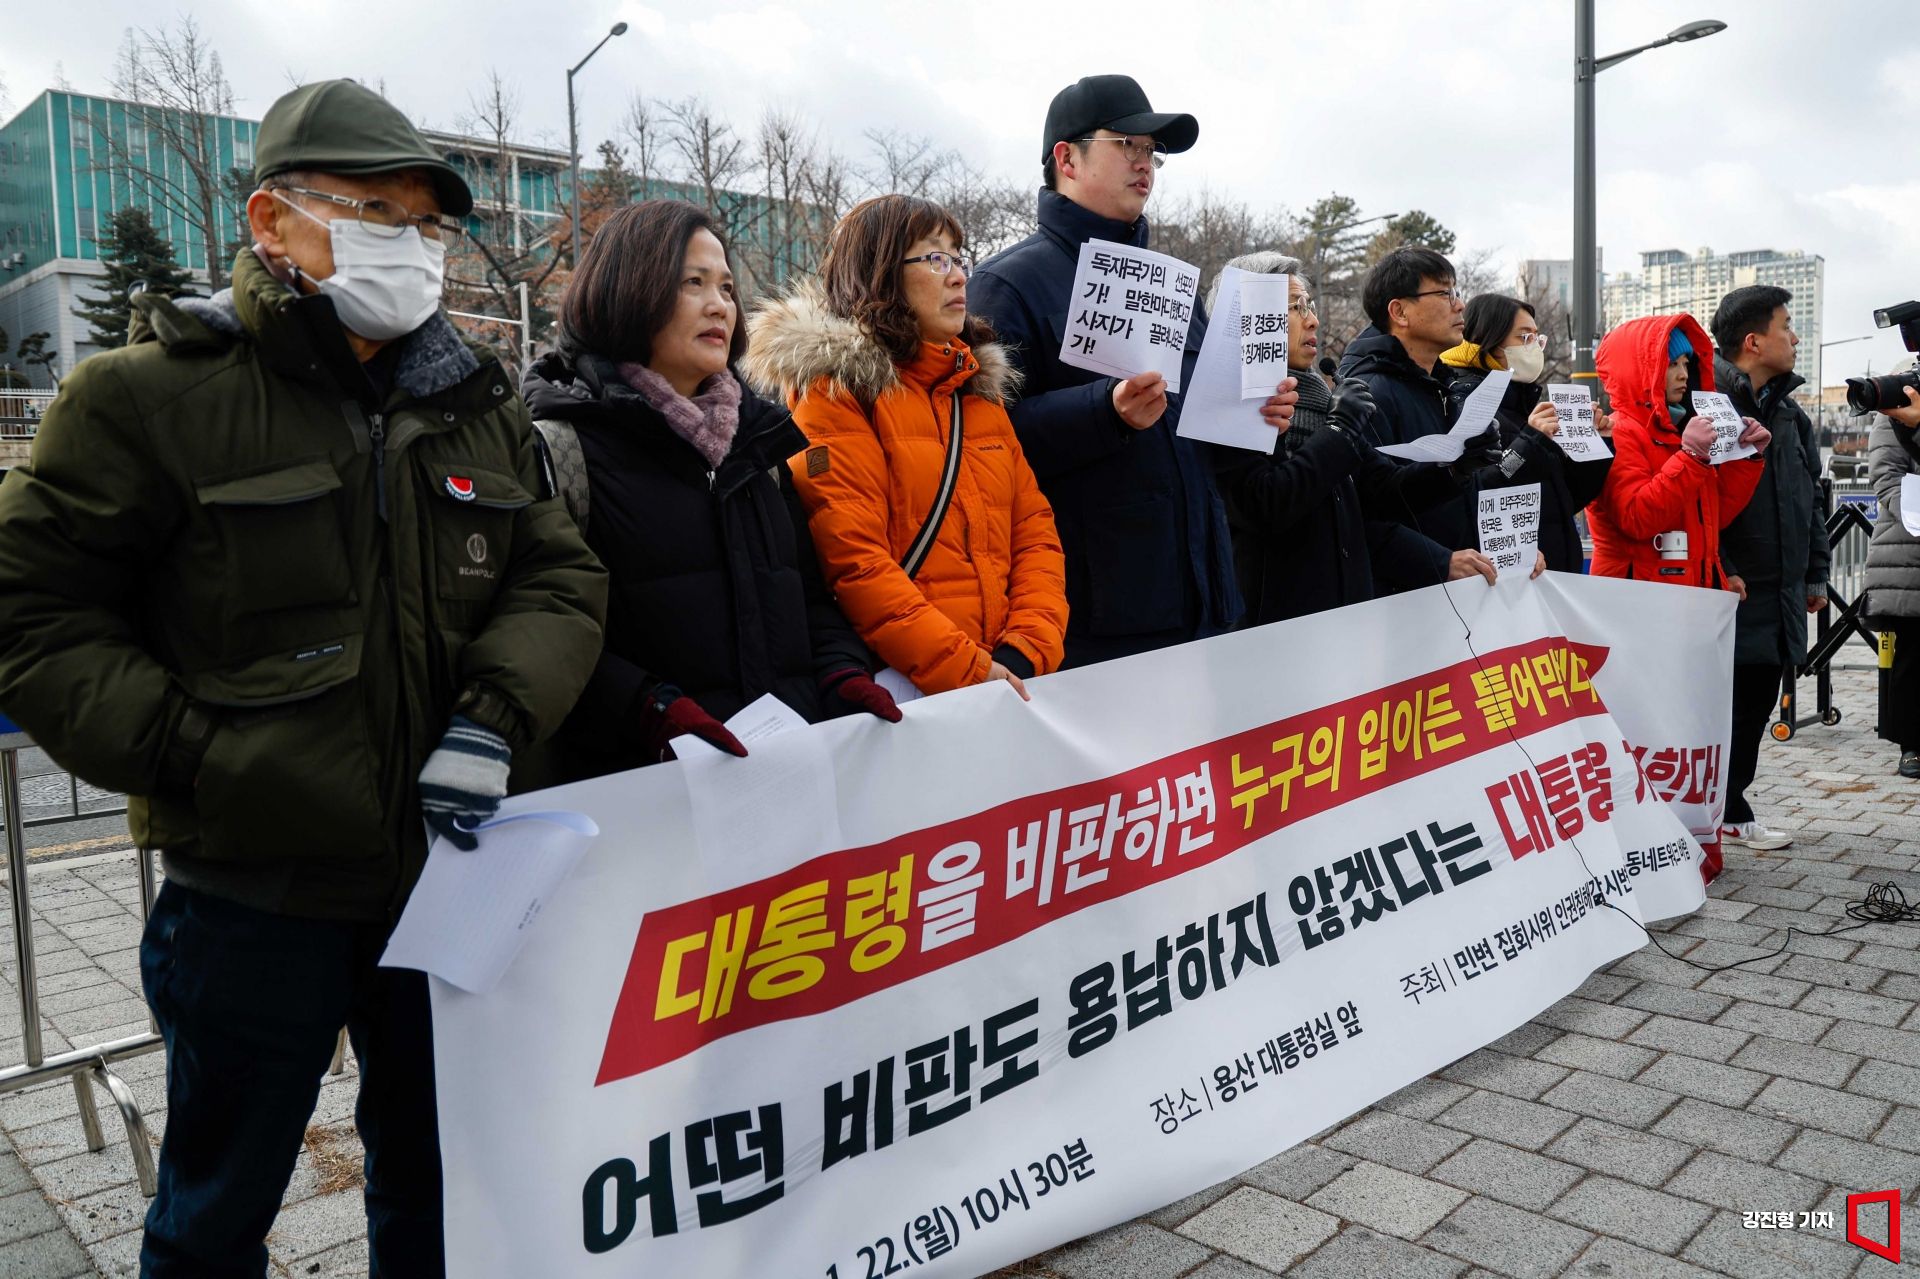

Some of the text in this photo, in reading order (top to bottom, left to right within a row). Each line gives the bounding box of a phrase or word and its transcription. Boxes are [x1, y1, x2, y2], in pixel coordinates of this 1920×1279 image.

[1091, 252, 1196, 297] 독재국가의 선포인
[1083, 282, 1110, 305] 가!
[1075, 310, 1133, 340] 사지가
[1070, 334, 1096, 355] 가!
[1480, 498, 1495, 514] 이게
[1481, 517, 1503, 535] 한국은
[654, 841, 984, 1024] 대통령을
[1005, 761, 1216, 906] 비판하면
[1231, 716, 1345, 829] 누구의
[1358, 683, 1466, 780] 입이든
[582, 1102, 785, 1254] 어떤
[821, 997, 1039, 1172] 비판도
[1067, 891, 1280, 1059] 용납하지
[1287, 821, 1492, 951] 않겠다는
[961, 1169, 1030, 1231] 10시
[1028, 1137, 1096, 1197] 30분
[1150, 1087, 1203, 1136] 장소
[1213, 1052, 1259, 1103] 용산
[1257, 1011, 1340, 1077] 대통령실
[1336, 1000, 1363, 1039] 앞
[1400, 962, 1447, 1005] 주최
[1453, 937, 1499, 981] 민변
[1494, 907, 1557, 962] 집회시위
